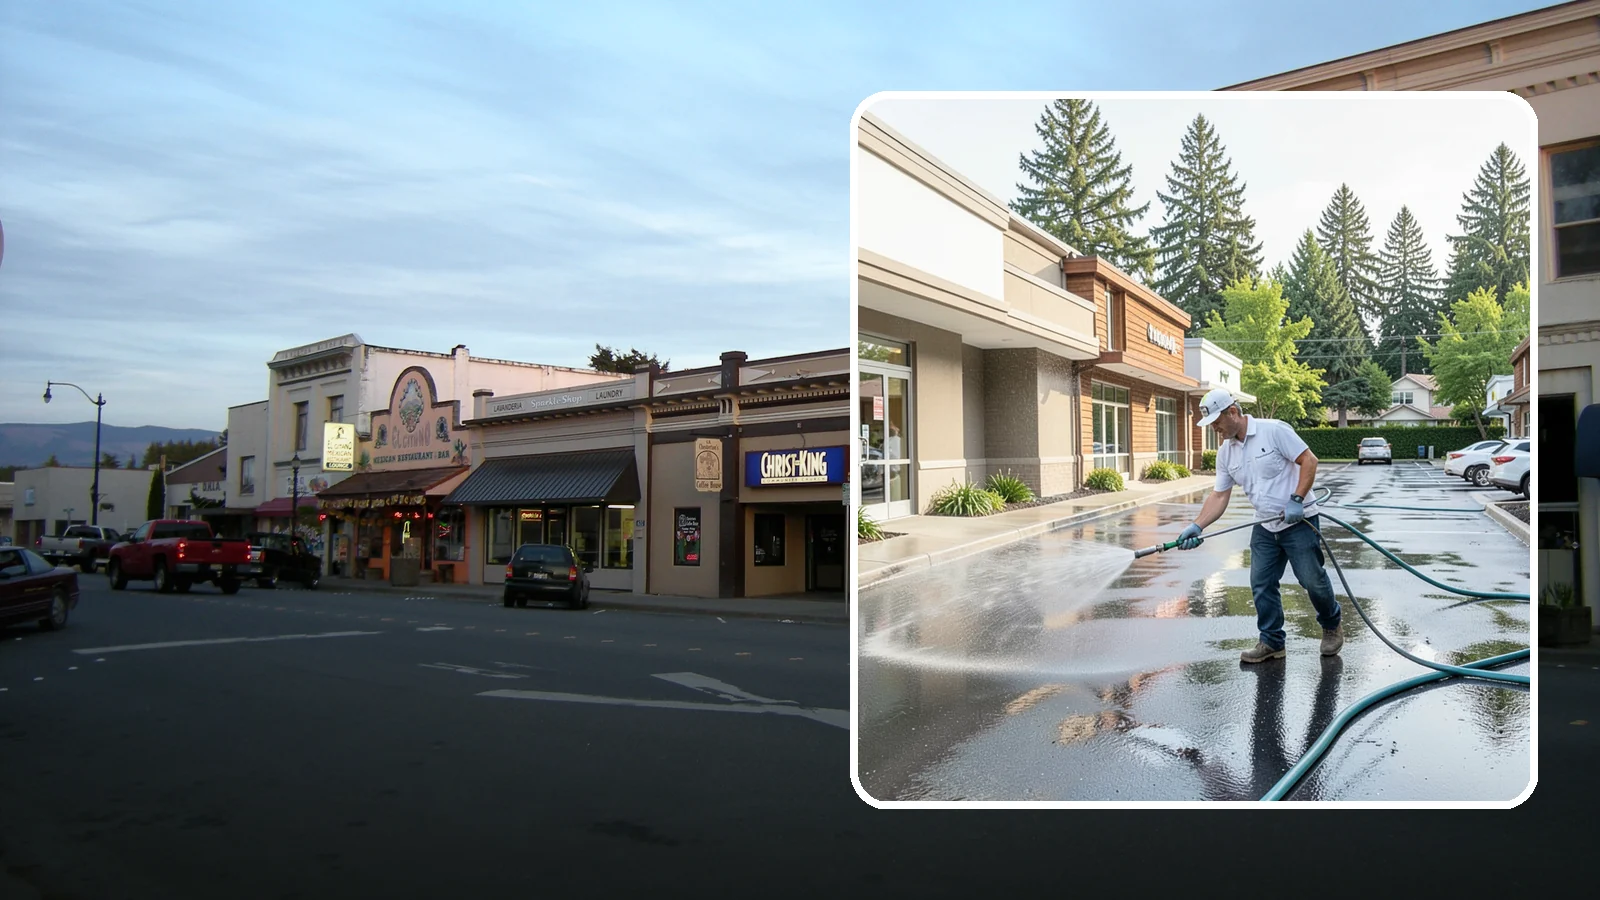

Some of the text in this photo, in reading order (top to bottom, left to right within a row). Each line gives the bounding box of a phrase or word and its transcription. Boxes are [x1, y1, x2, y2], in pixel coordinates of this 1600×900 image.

[493, 388, 624, 413] LAVANDERIA Sparkle Shop LAUNDRY
[373, 450, 450, 464] MEXICAN RESTAURANT BAR
[761, 449, 827, 478] CHRIST KING
